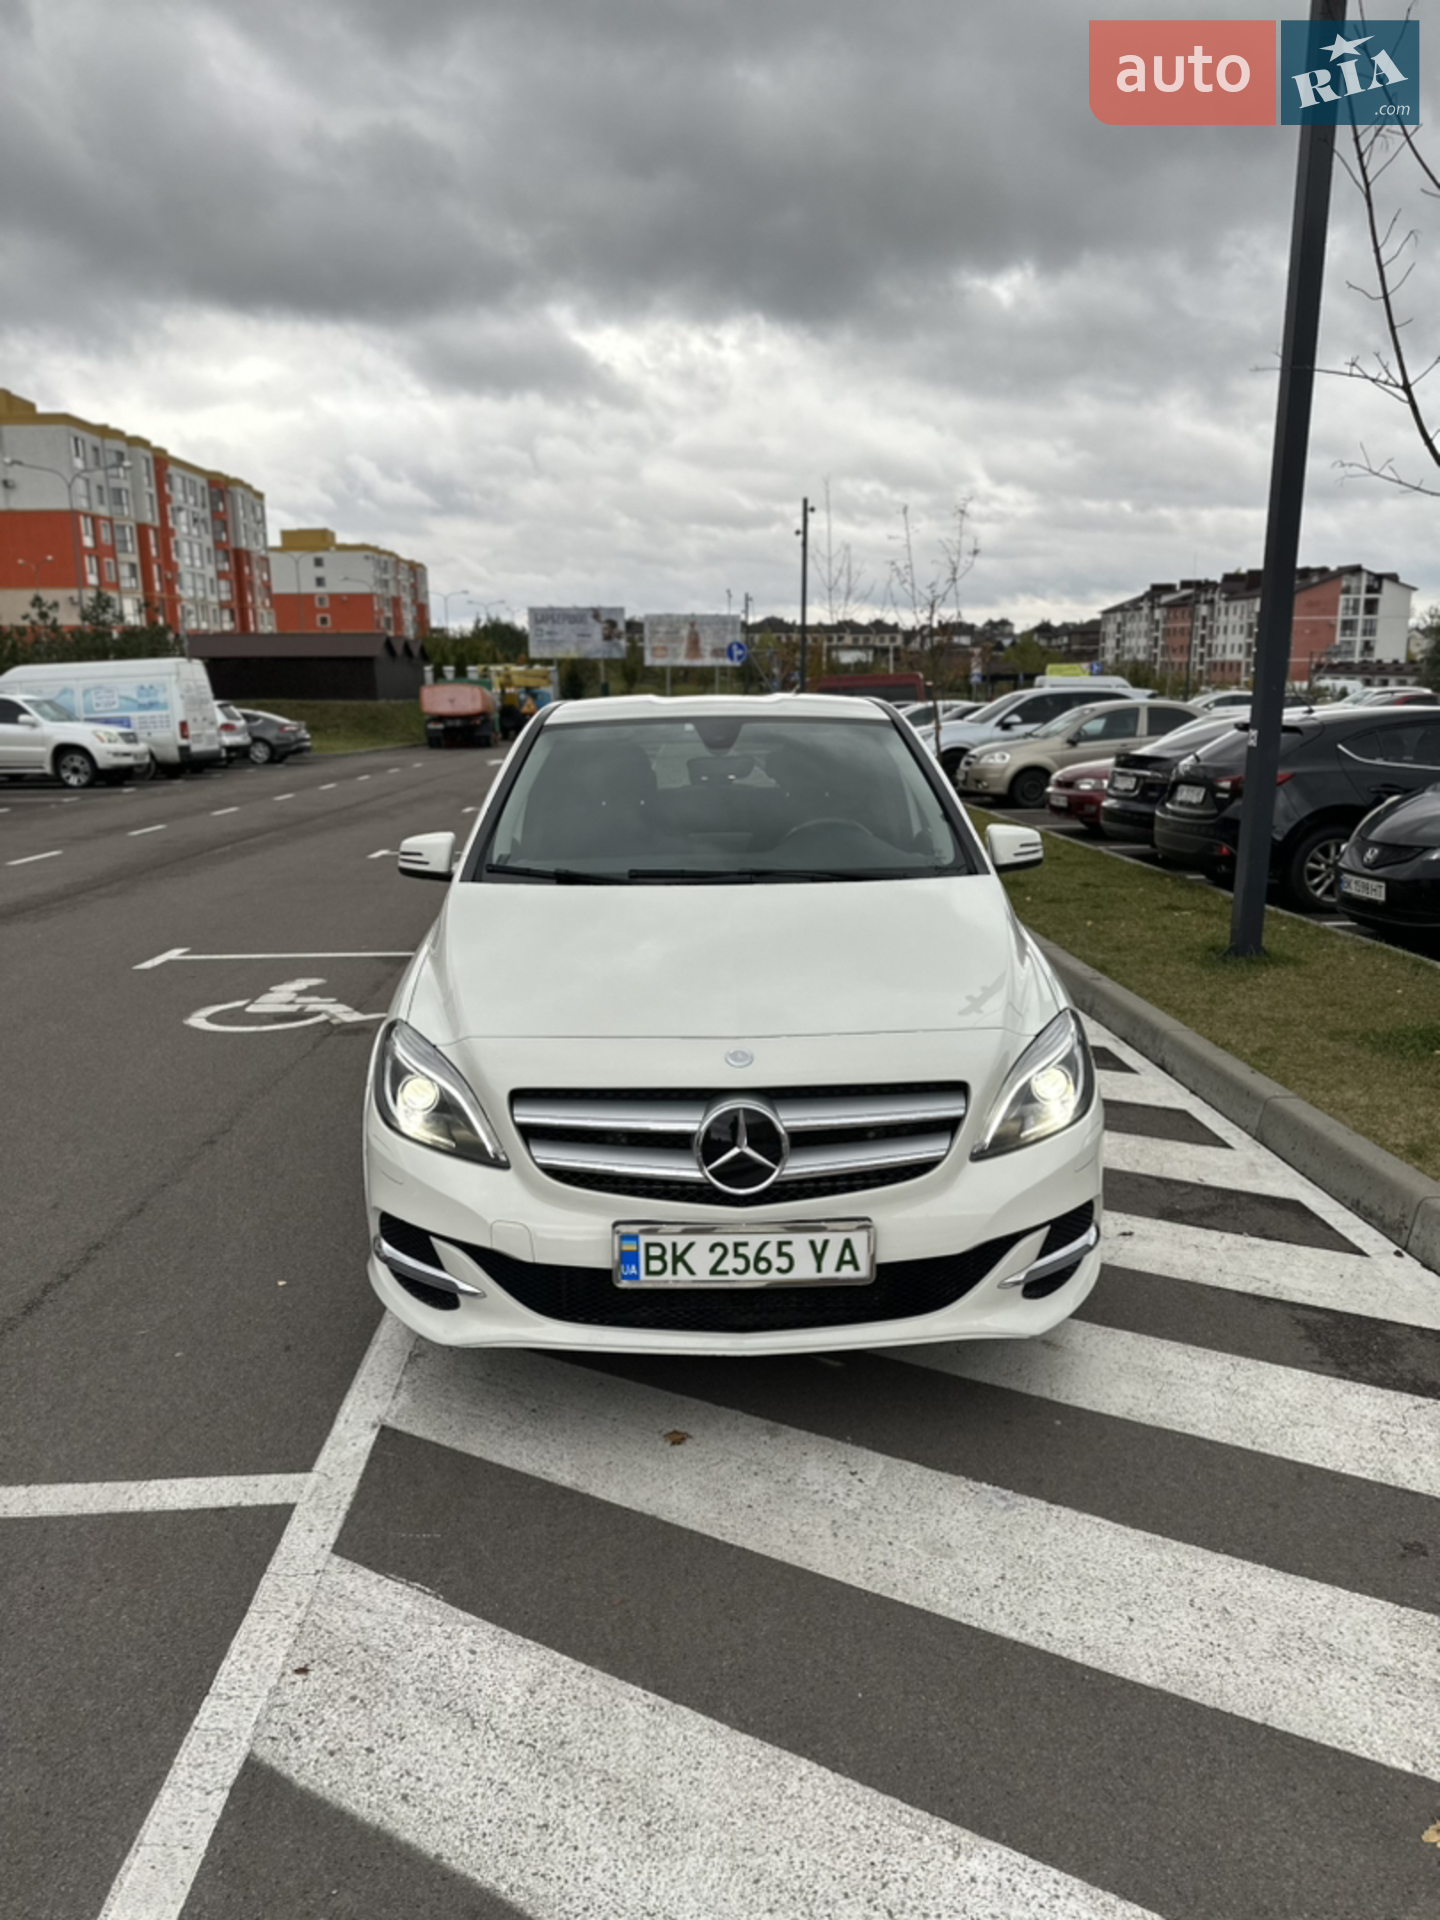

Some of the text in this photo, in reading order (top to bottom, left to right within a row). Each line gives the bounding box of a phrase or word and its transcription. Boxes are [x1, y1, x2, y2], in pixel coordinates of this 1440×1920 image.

[621, 1263, 638, 1276] UA
[644, 1238, 860, 1276] BK 2565 YA
